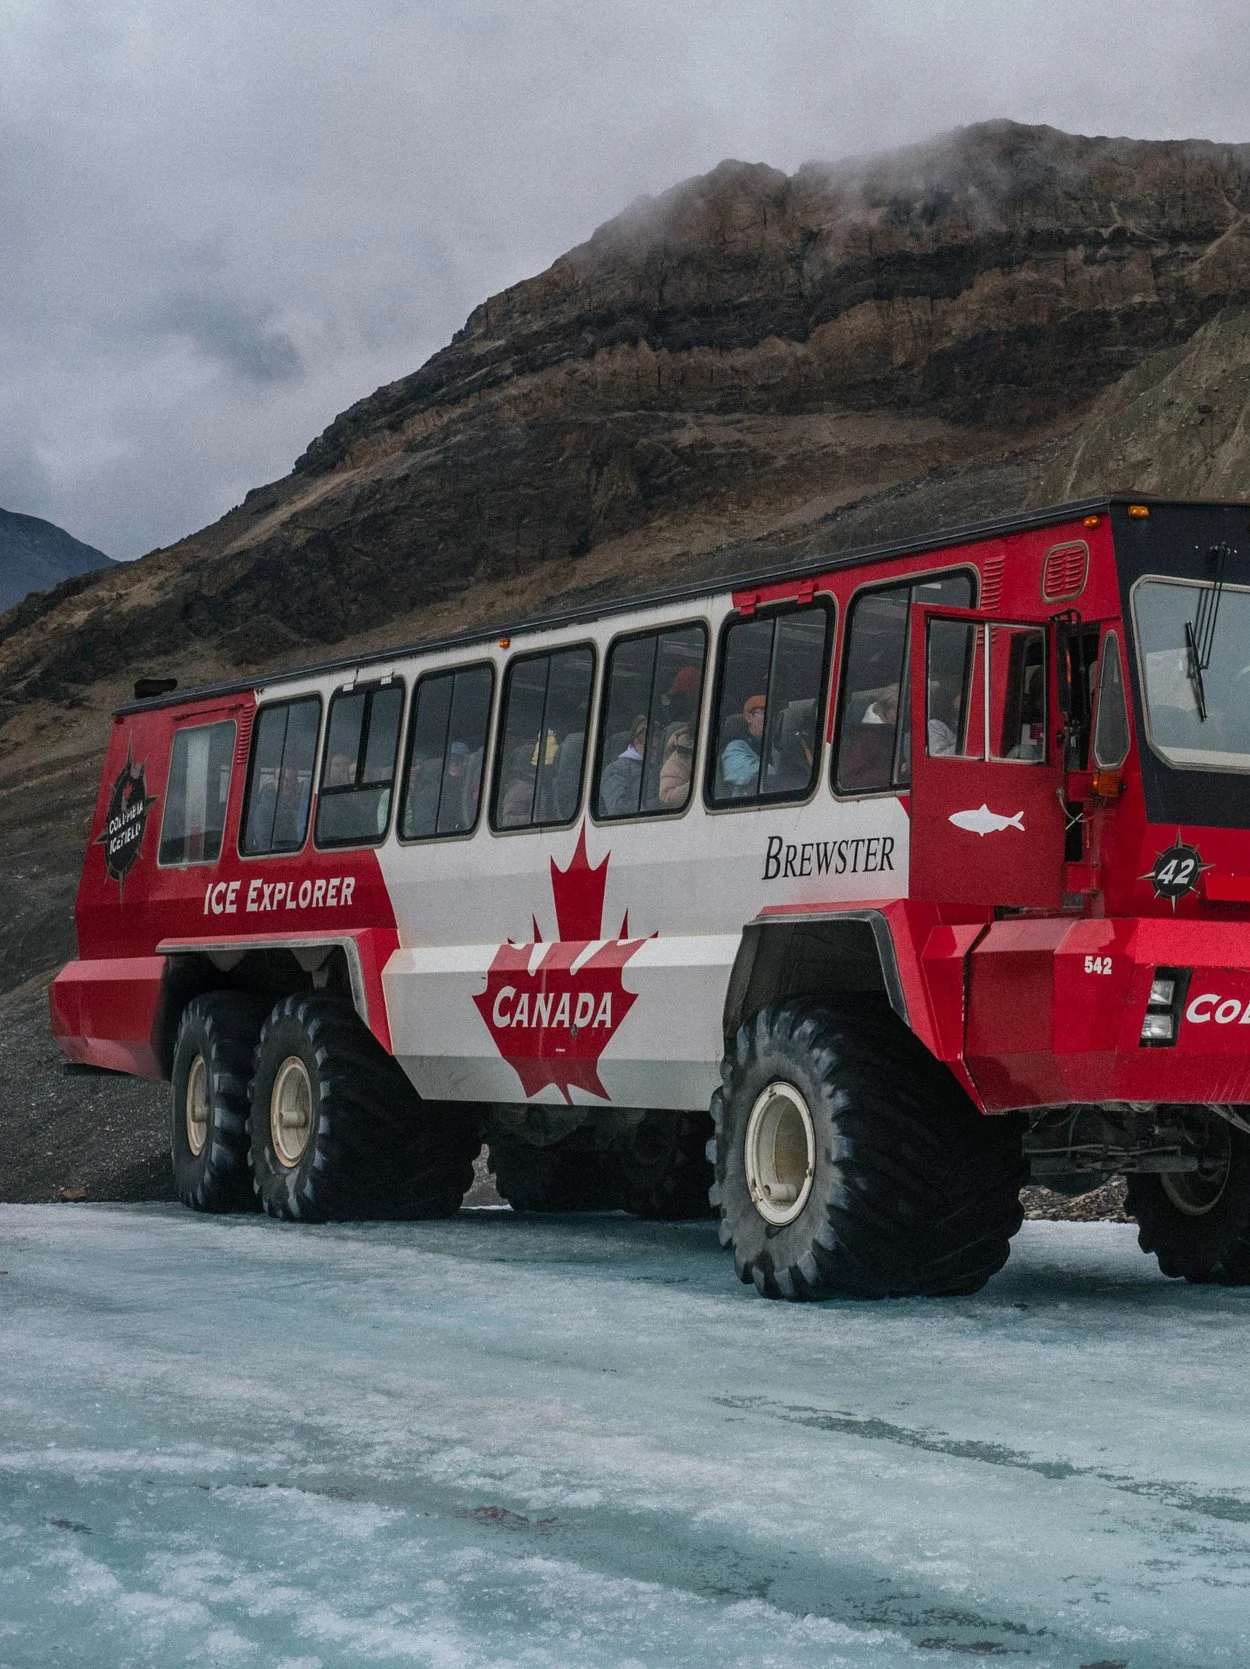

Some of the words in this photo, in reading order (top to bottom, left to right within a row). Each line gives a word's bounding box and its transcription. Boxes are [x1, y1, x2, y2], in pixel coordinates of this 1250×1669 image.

[761, 835, 895, 880] BREWSTER
[1157, 859, 1195, 884] 42
[203, 880, 241, 915] ICE
[246, 877, 355, 912] EXPLORER
[1084, 956, 1112, 975] 542
[492, 985, 612, 1028] CANADA
